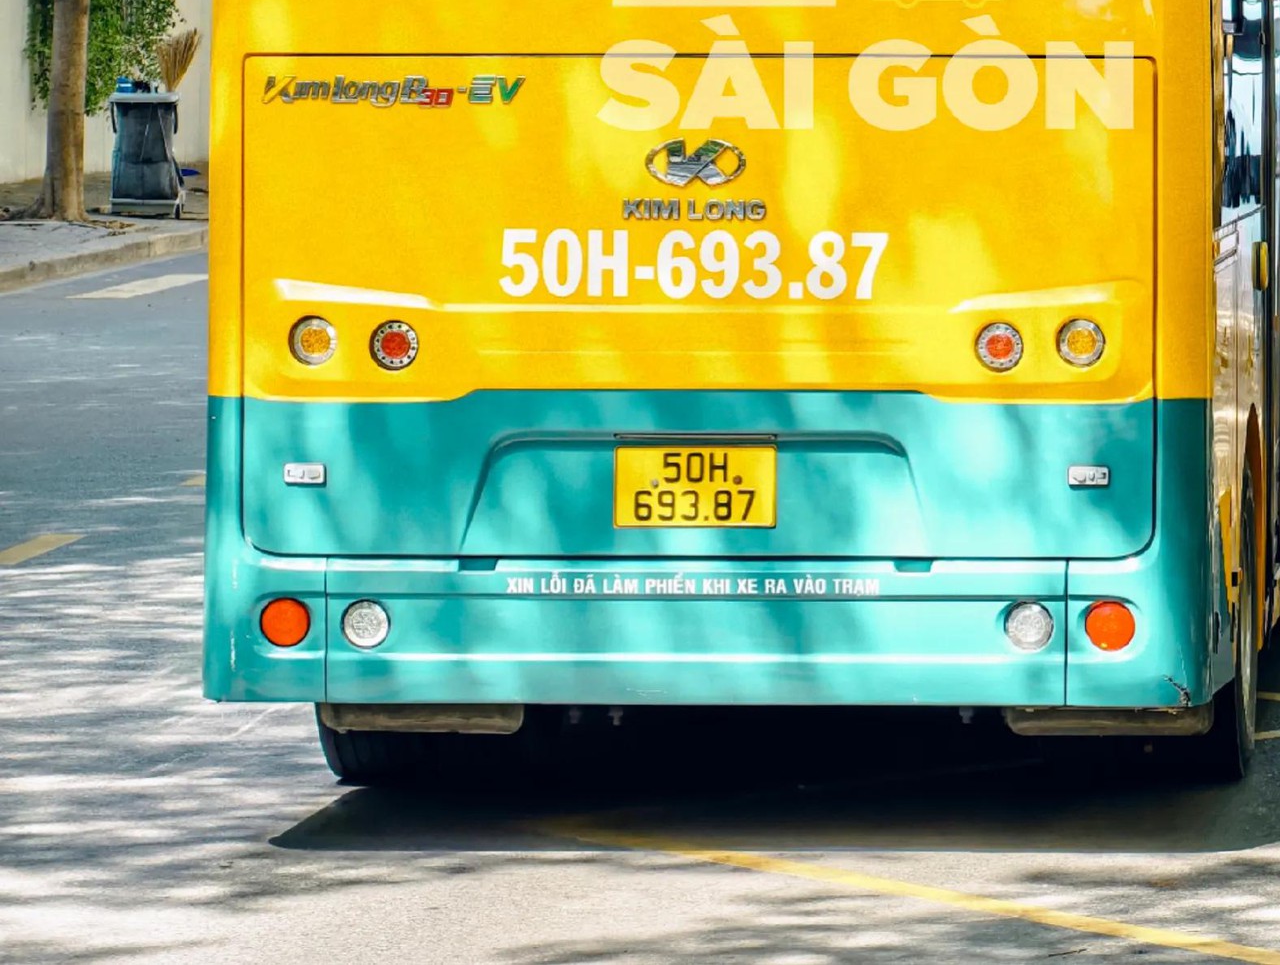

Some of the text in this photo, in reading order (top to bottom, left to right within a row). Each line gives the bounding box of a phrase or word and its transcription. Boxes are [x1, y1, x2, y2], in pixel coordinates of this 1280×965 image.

[622, 198, 767, 221] KIM LONG
[499, 228, 889, 300] 50H-693.87
[663, 452, 728, 484] 50H
[633, 490, 756, 522] 693.87
[506, 577, 534, 594] XIN
[573, 574, 596, 594] ĐÃ
[603, 574, 638, 594] LÀM
[702, 579, 730, 594] KHI
[737, 578, 758, 594] XE
[765, 578, 787, 594] RA
[793, 575, 826, 594] VÀO
[833, 578, 880, 597] TRẠM
